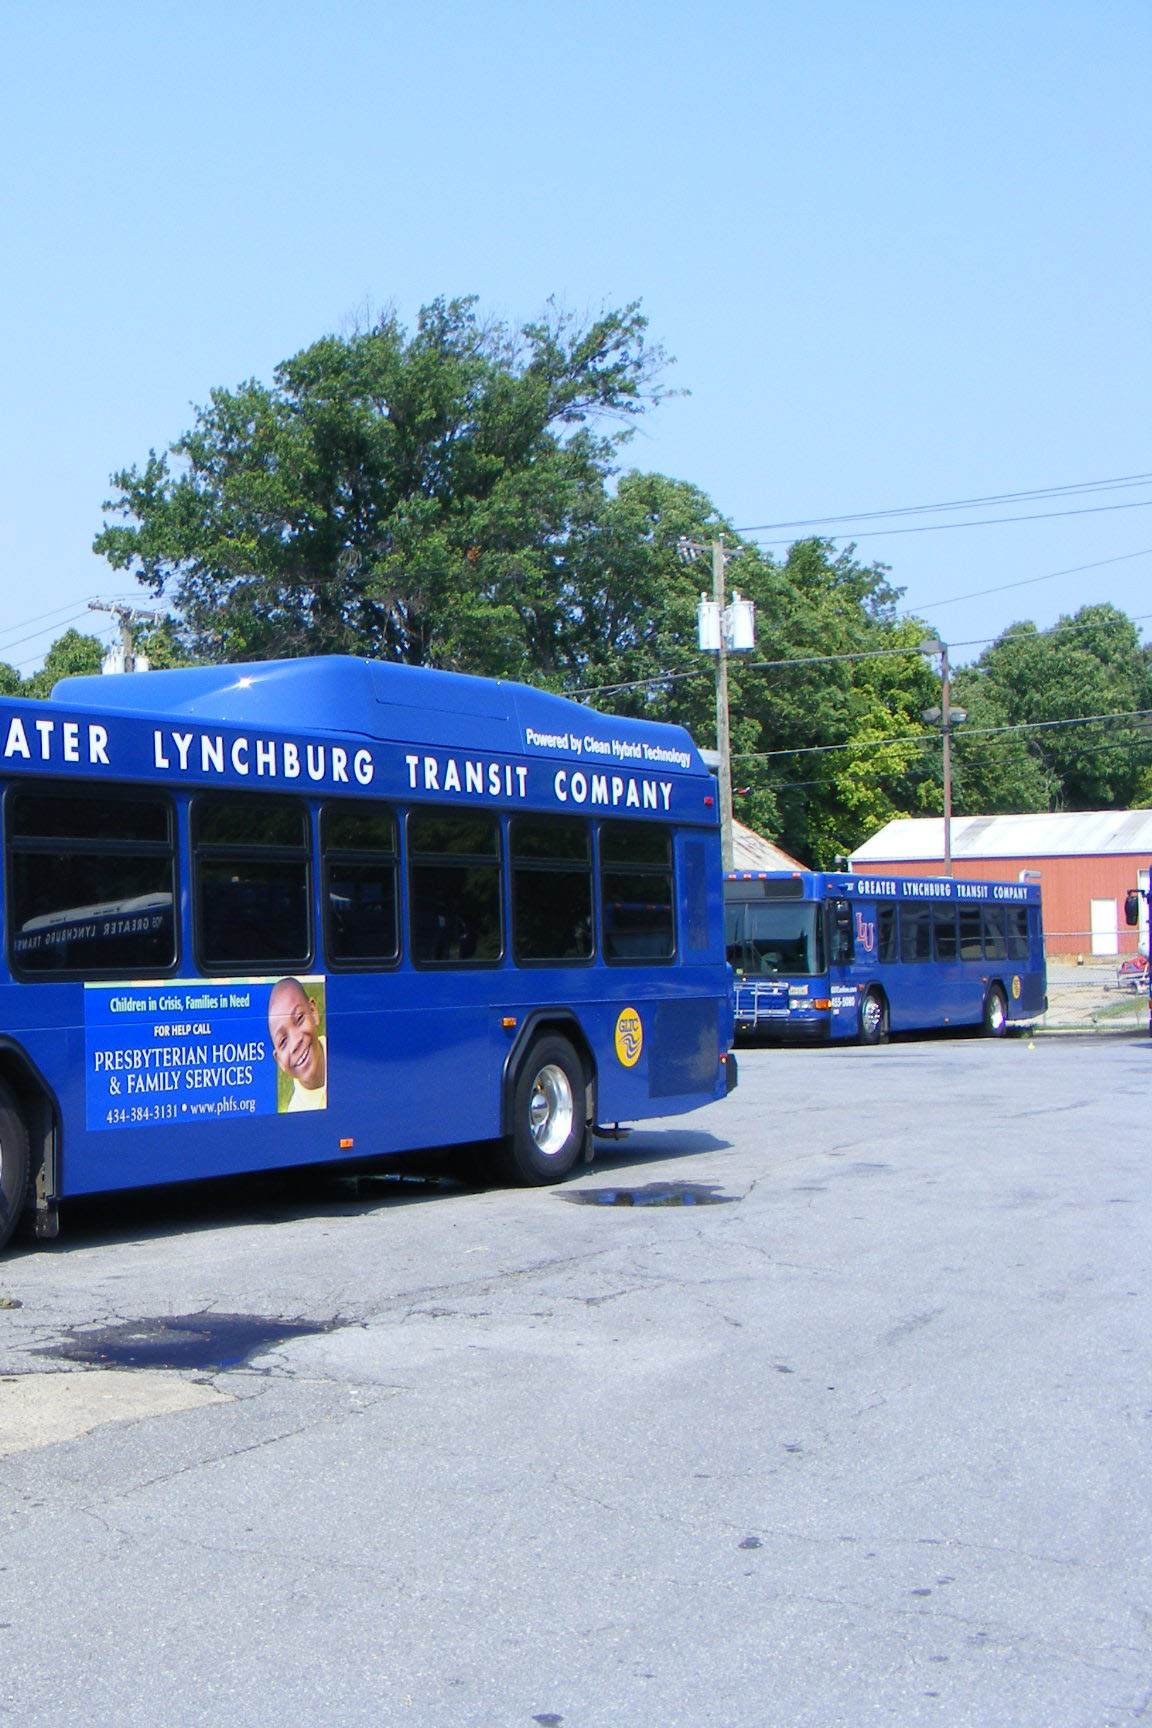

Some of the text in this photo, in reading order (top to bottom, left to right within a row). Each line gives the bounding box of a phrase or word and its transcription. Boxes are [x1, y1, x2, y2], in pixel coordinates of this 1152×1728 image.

[525, 728, 691, 768] Powered by Clean Hybrid Technology
[153, 730, 375, 785] LYNCHBURG
[405, 755, 528, 797] TRANSIT
[554, 770, 673, 811] COMPANY
[857, 879, 896, 896] GREATER
[902, 881, 951, 897] LYNCHBURG
[956, 883, 988, 899] TRANSIT
[993, 885, 1028, 900] COMPANY
[109, 993, 250, 1013] Children in Crisis, Families in Need
[154, 1023, 211, 1037] FOR HELP CALL
[618, 1018, 639, 1033] GLTC
[94, 1042, 266, 1072] PRESBYTERIAN HOMES
[108, 1066, 253, 1095] & FAMILY SERVICES
[106, 1097, 256, 1124] 434-384-3131 www.phfs.org
